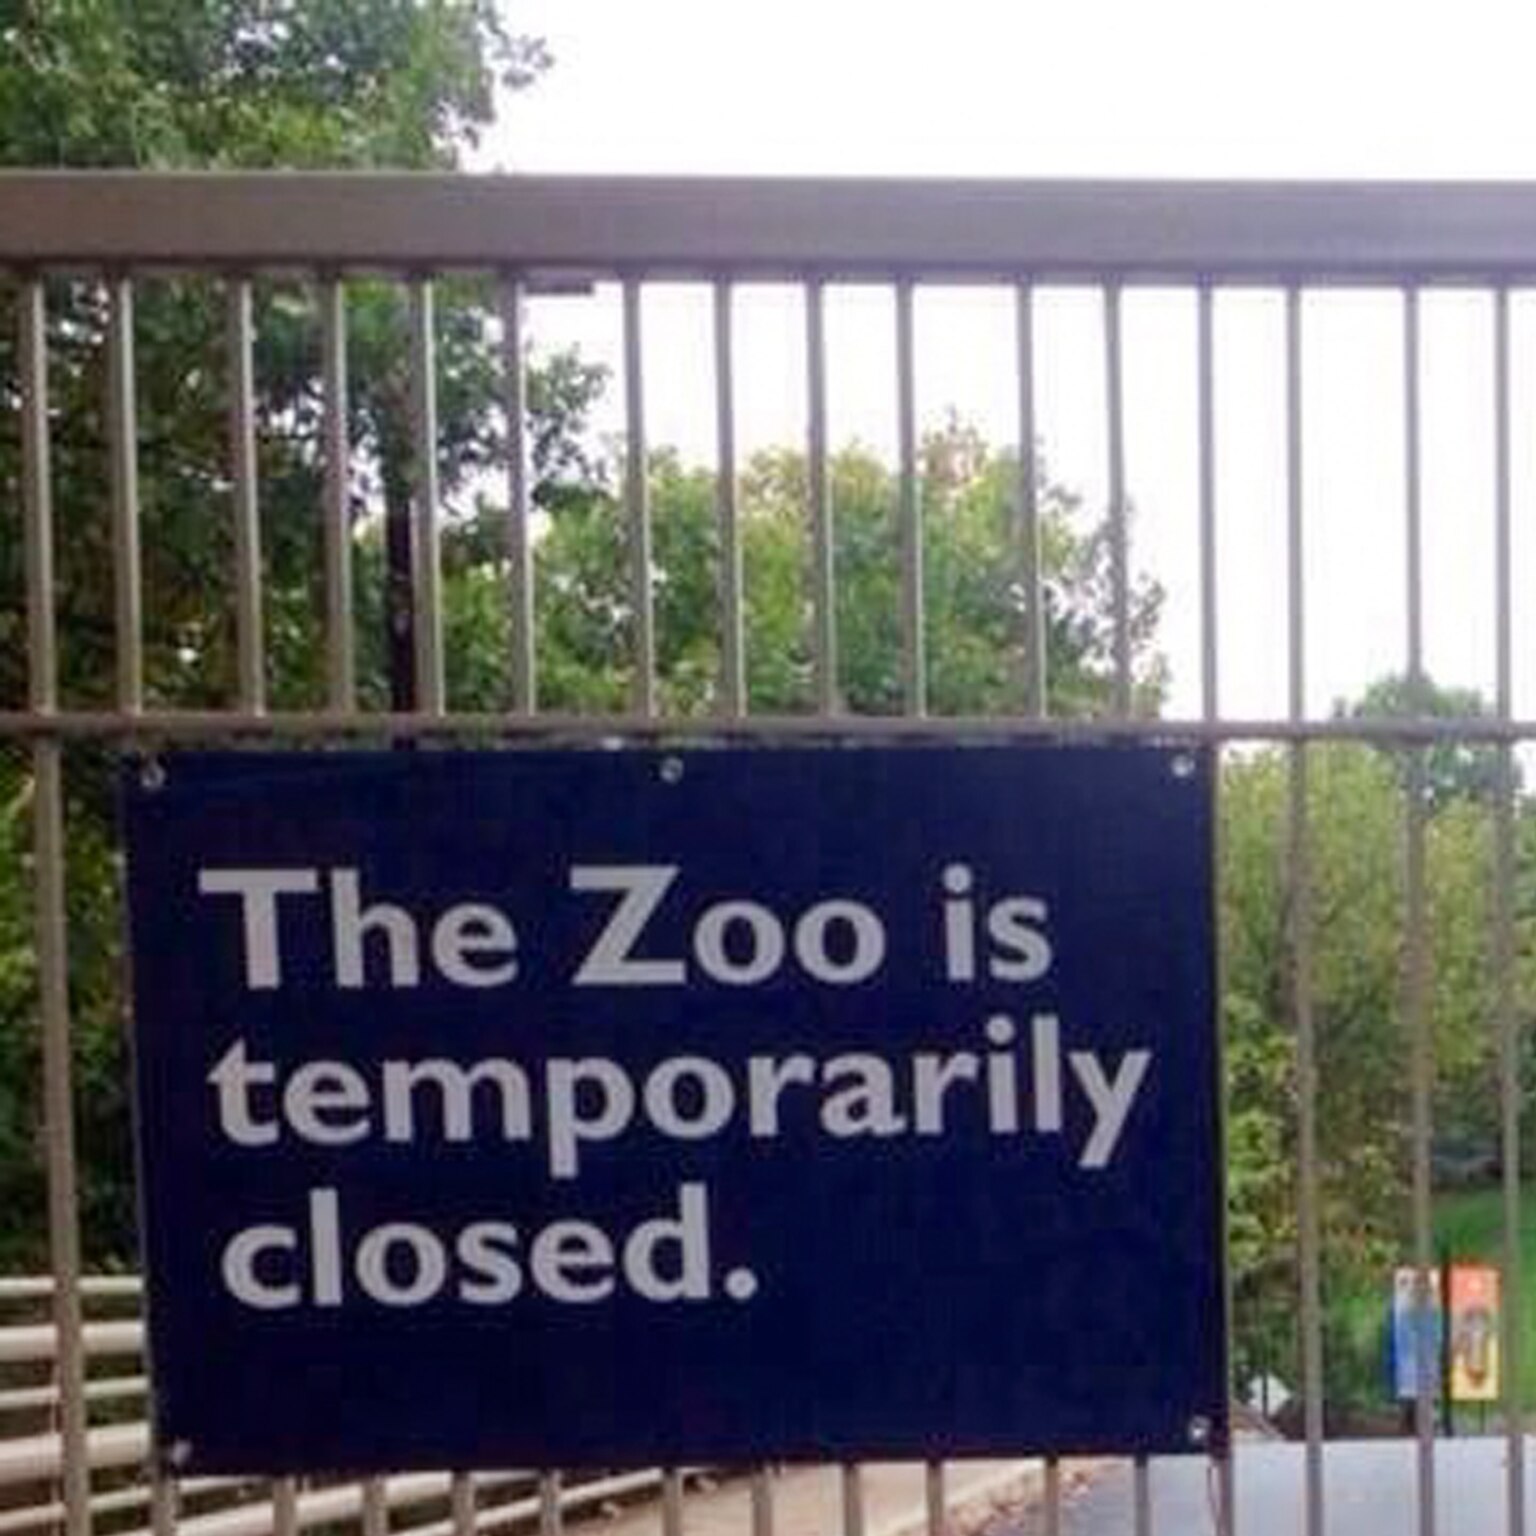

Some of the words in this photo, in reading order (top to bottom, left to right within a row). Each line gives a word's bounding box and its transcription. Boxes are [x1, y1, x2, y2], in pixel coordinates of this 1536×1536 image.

[199, 868, 517, 989] The
[571, 865, 885, 985] Zoo
[944, 864, 1051, 981] is
[208, 1014, 1151, 1178] temporarily
[222, 1182, 758, 1308] closed.
